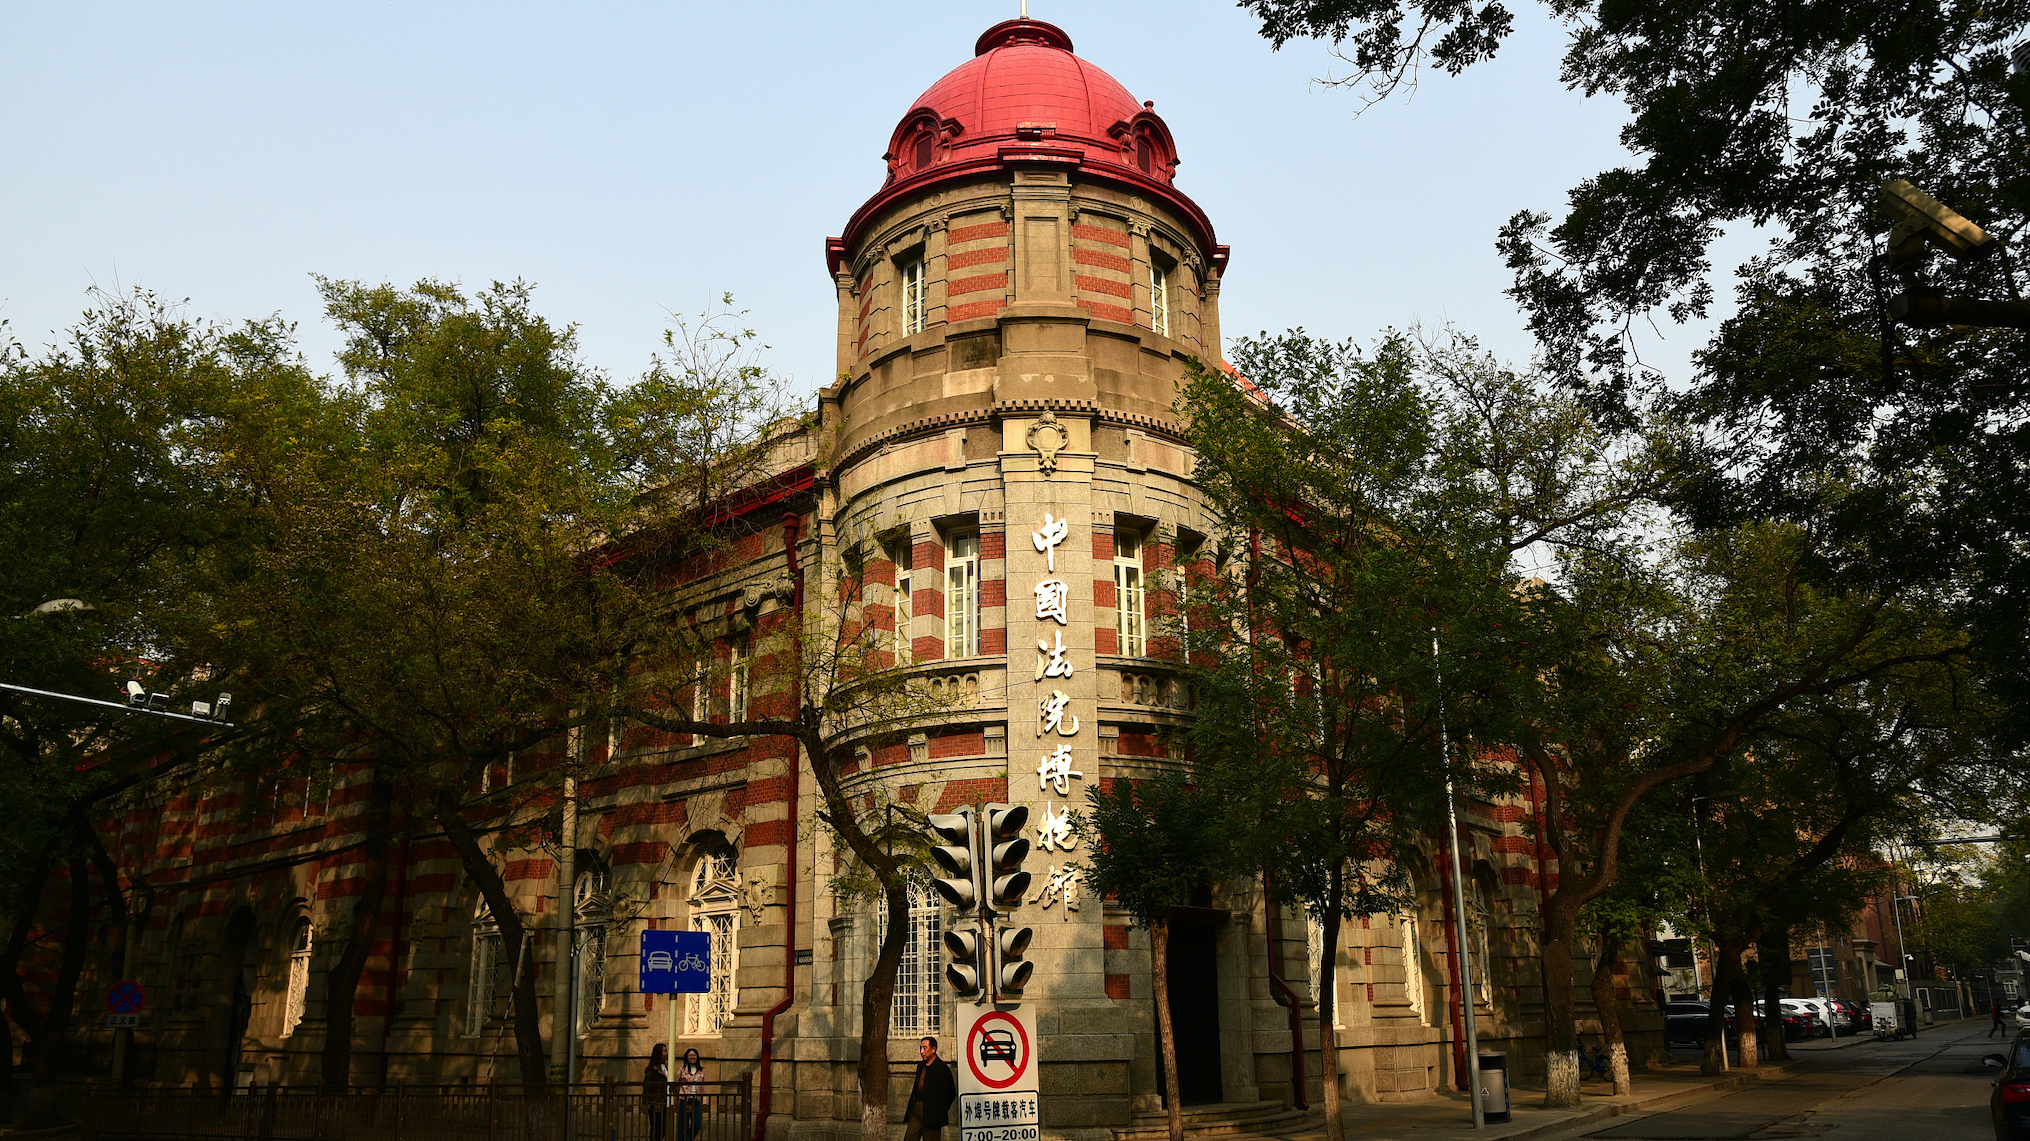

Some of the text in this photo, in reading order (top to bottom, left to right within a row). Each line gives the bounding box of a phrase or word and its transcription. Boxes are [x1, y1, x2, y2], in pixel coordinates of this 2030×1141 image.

[110, 1016, 136, 1025] 正义路
[965, 1099, 1036, 1122] 外埠号牌载客汽车
